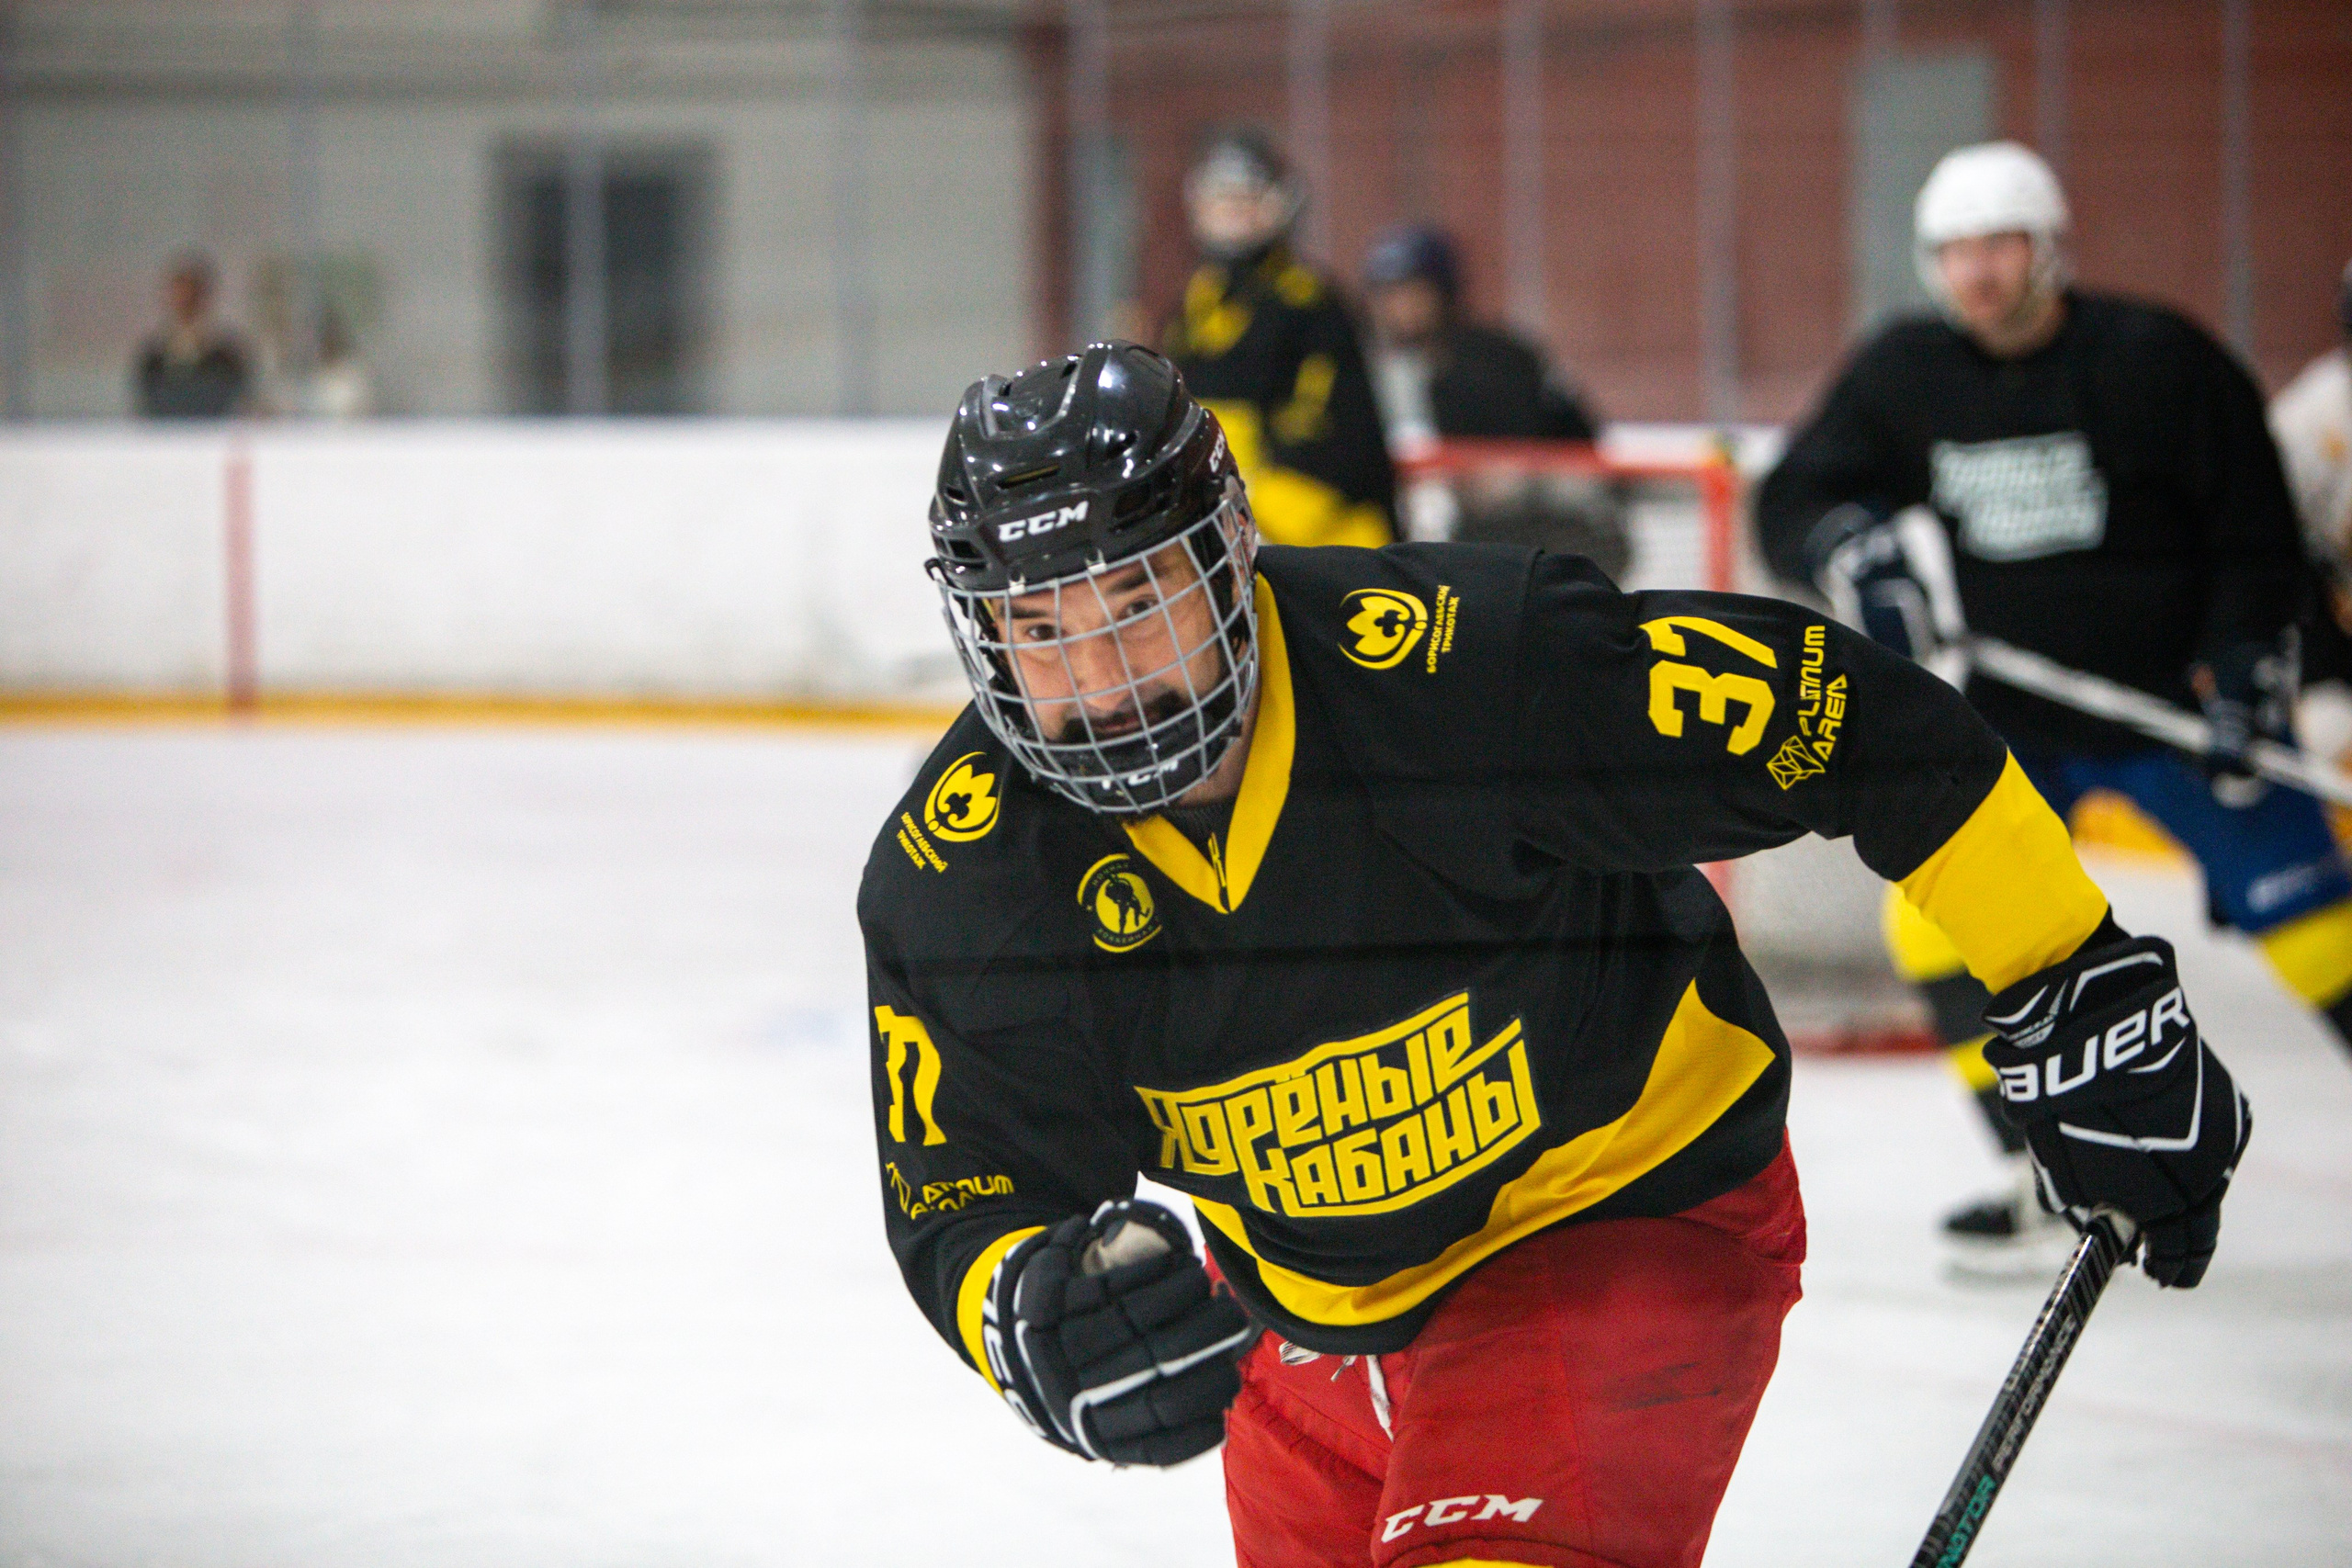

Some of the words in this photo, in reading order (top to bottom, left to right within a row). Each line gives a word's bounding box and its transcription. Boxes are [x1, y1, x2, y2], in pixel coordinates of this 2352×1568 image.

[998, 500, 1089, 543] CCM
[1441, 597, 1460, 653] ТРИКОТАЖ
[1638, 615, 1777, 756] 37
[1999, 986, 2192, 1103] AUER
[1380, 1494, 1544, 1543] CCM
